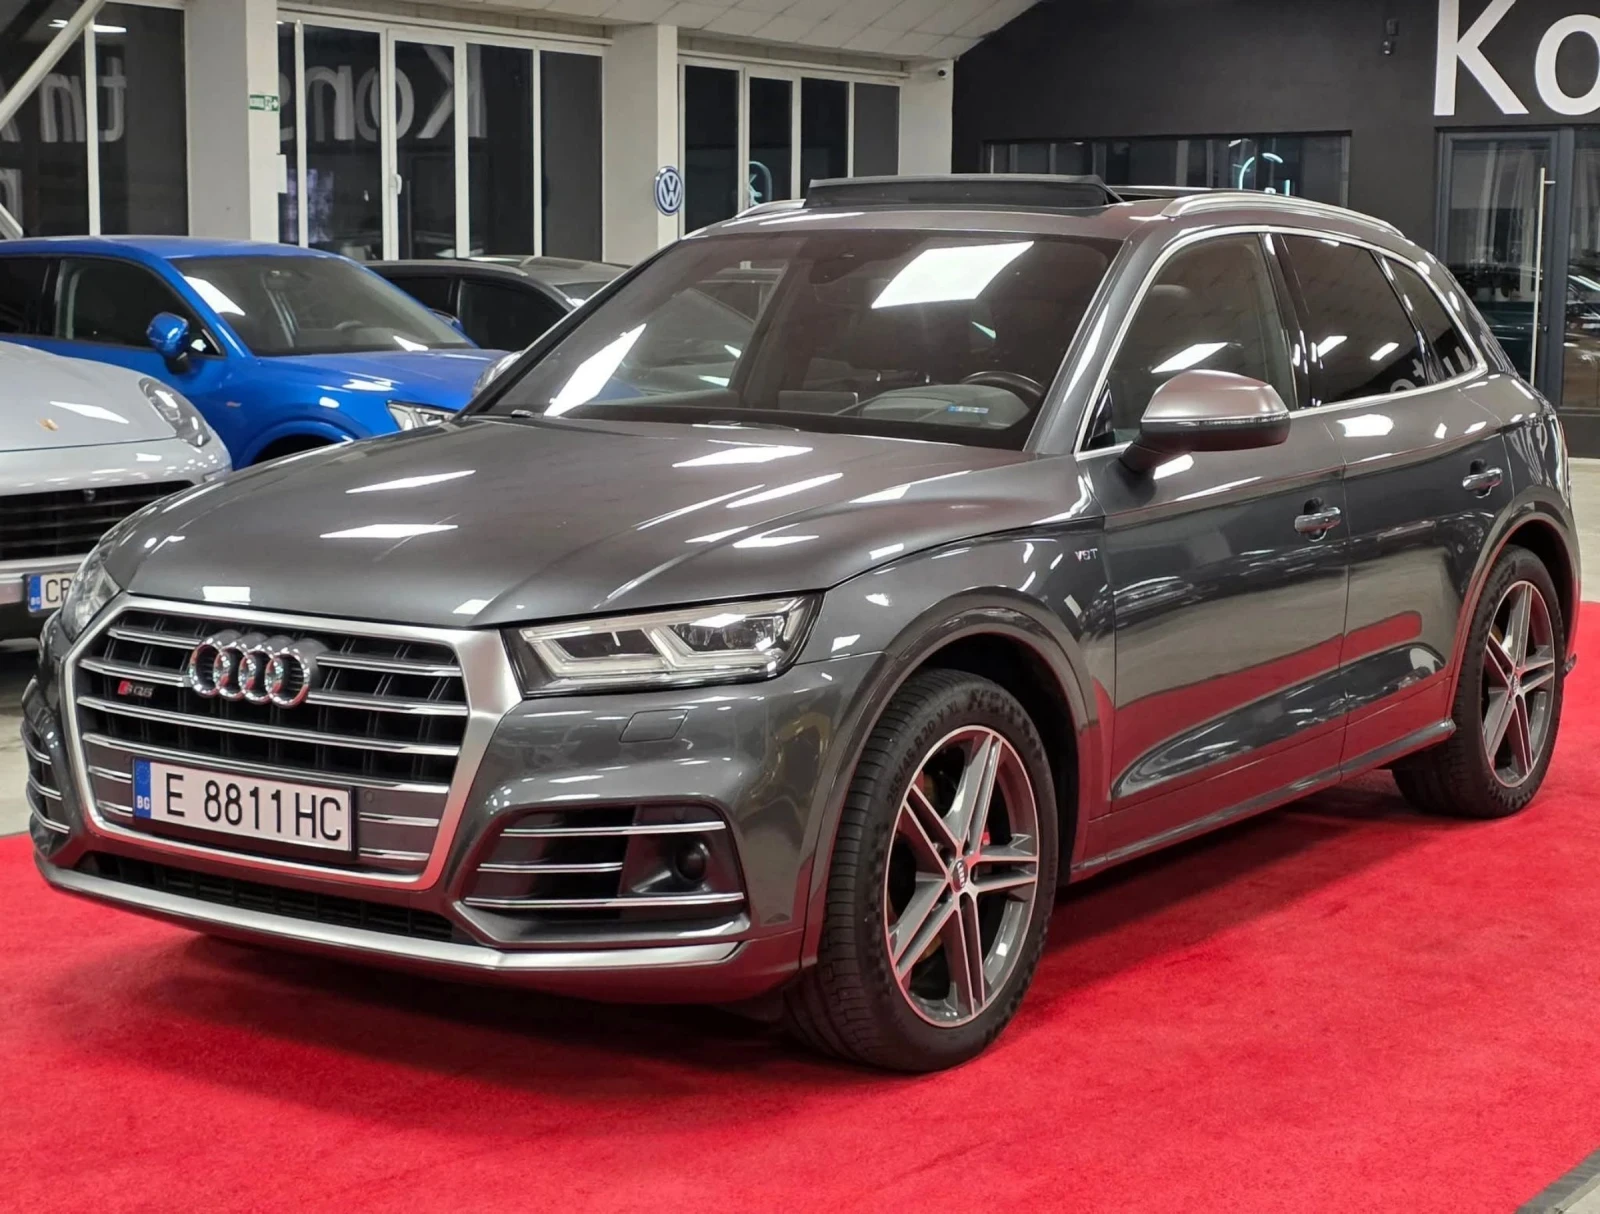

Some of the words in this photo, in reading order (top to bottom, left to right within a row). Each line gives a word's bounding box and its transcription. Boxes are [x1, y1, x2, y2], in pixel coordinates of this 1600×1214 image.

[1434, 0, 1600, 116] Ko
[136, 795, 151, 810] BG
[166, 772, 185, 817] E
[204, 780, 282, 833] 8811
[295, 792, 342, 841] HC
